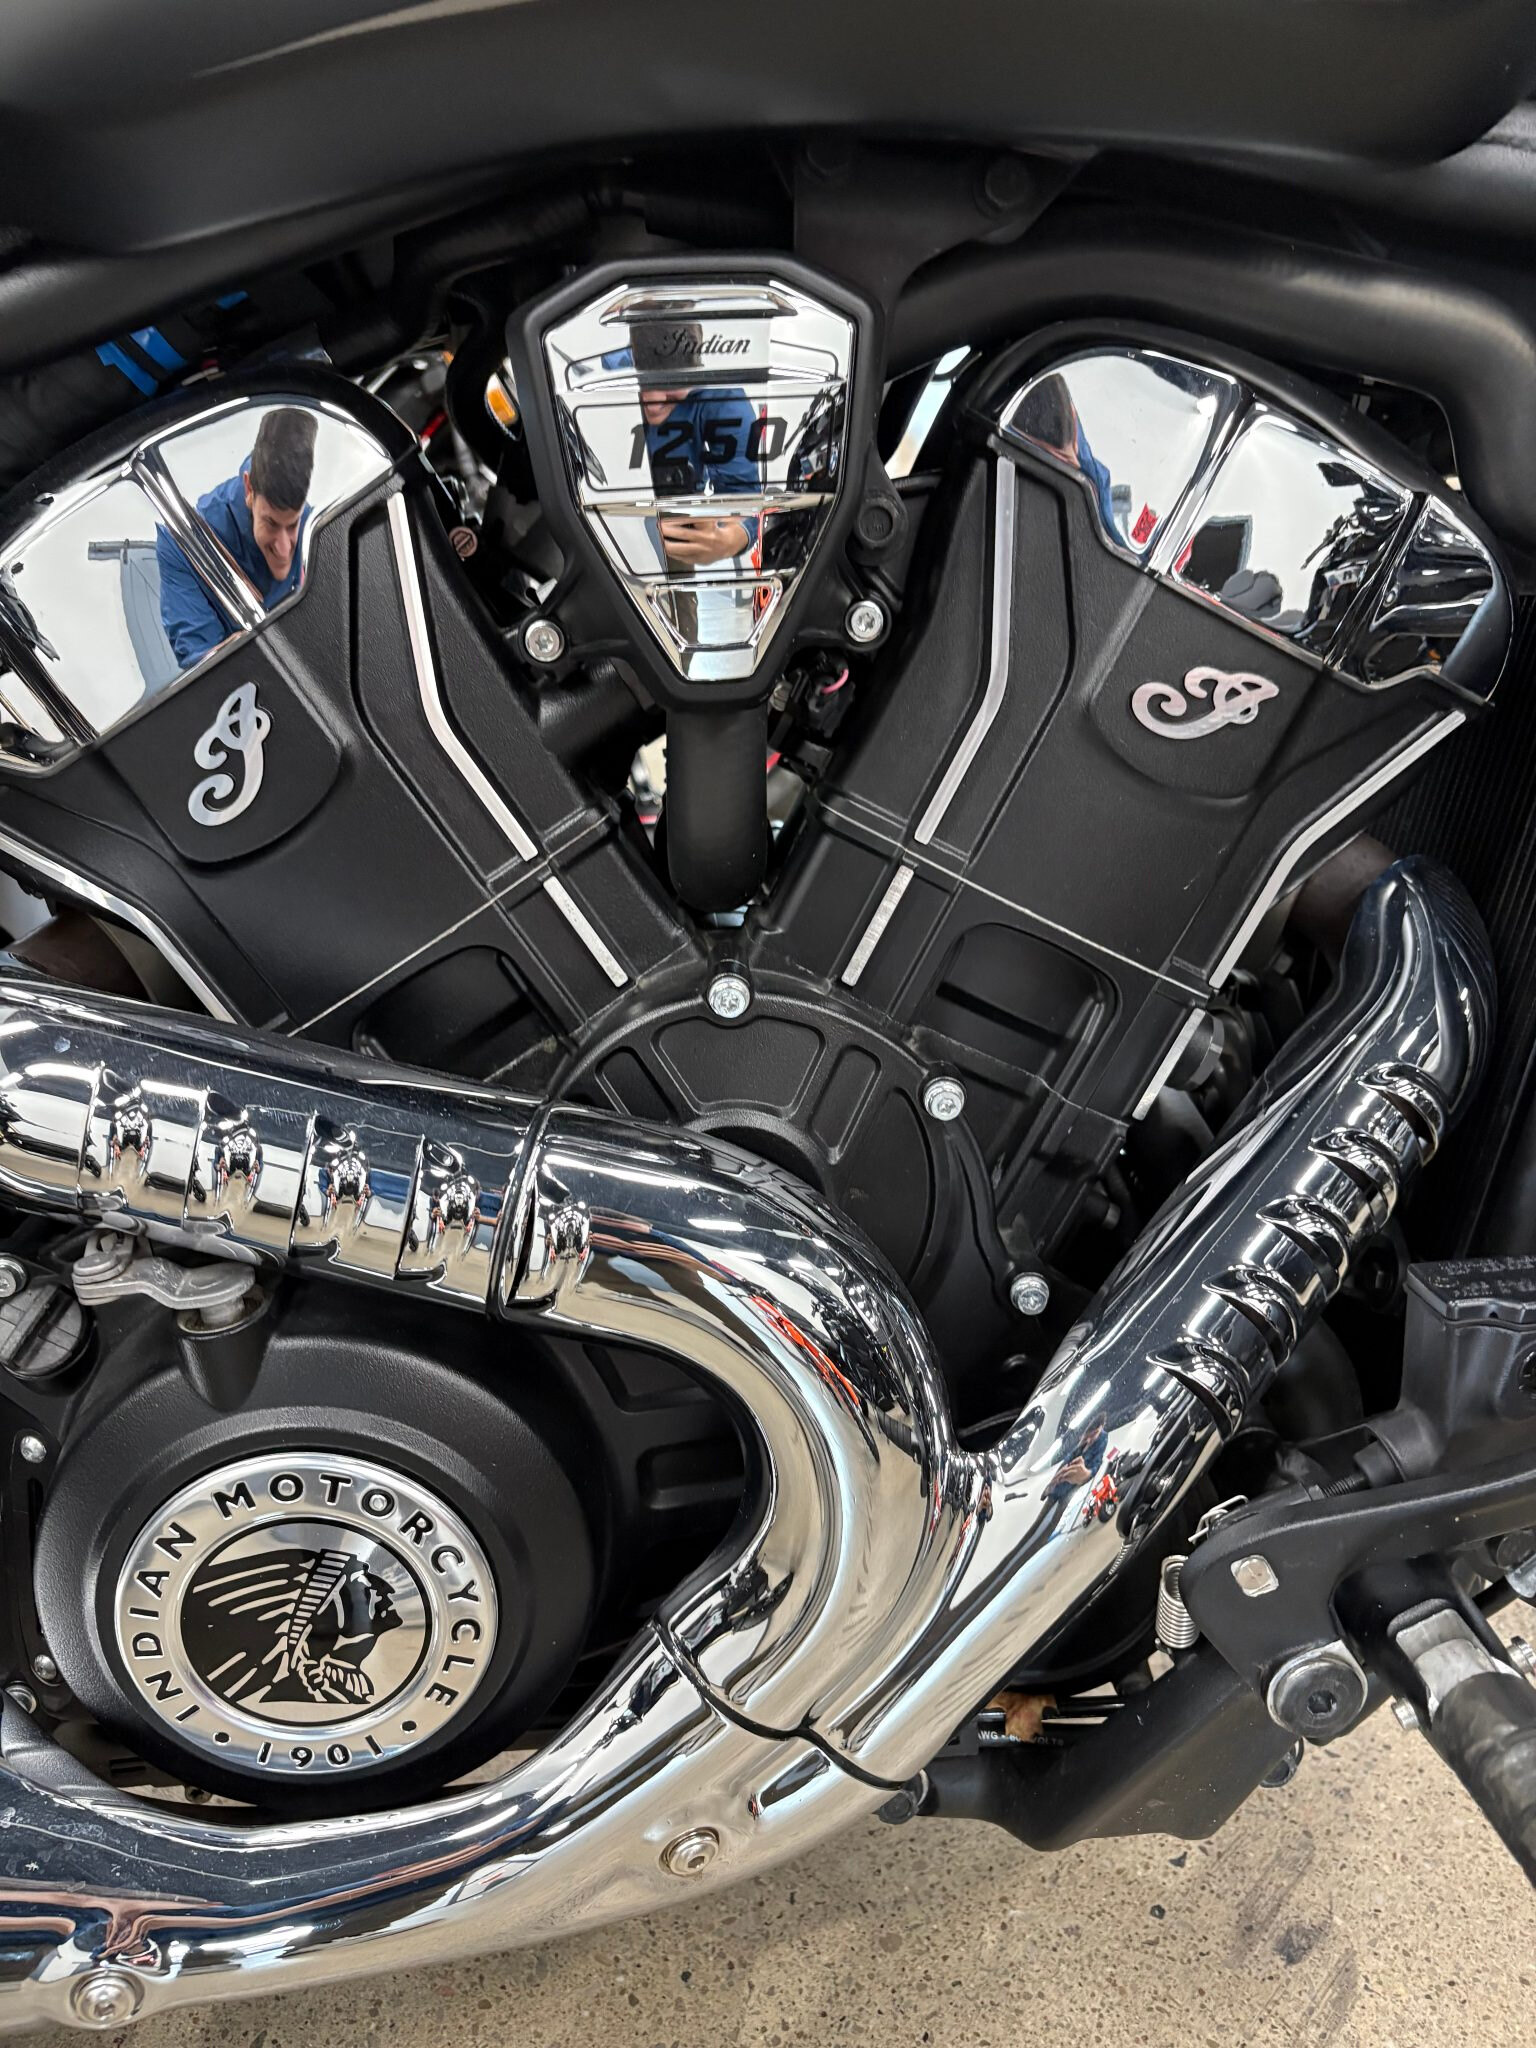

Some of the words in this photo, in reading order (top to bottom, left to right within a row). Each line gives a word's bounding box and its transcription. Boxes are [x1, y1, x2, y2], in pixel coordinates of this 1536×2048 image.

[654, 328, 751, 356] Indian
[629, 417, 788, 469] 1250
[129, 1521, 200, 1723] INDIAN
[211, 1473, 483, 1708] MOTORCYCLE
[256, 1734, 386, 1769] 1901
